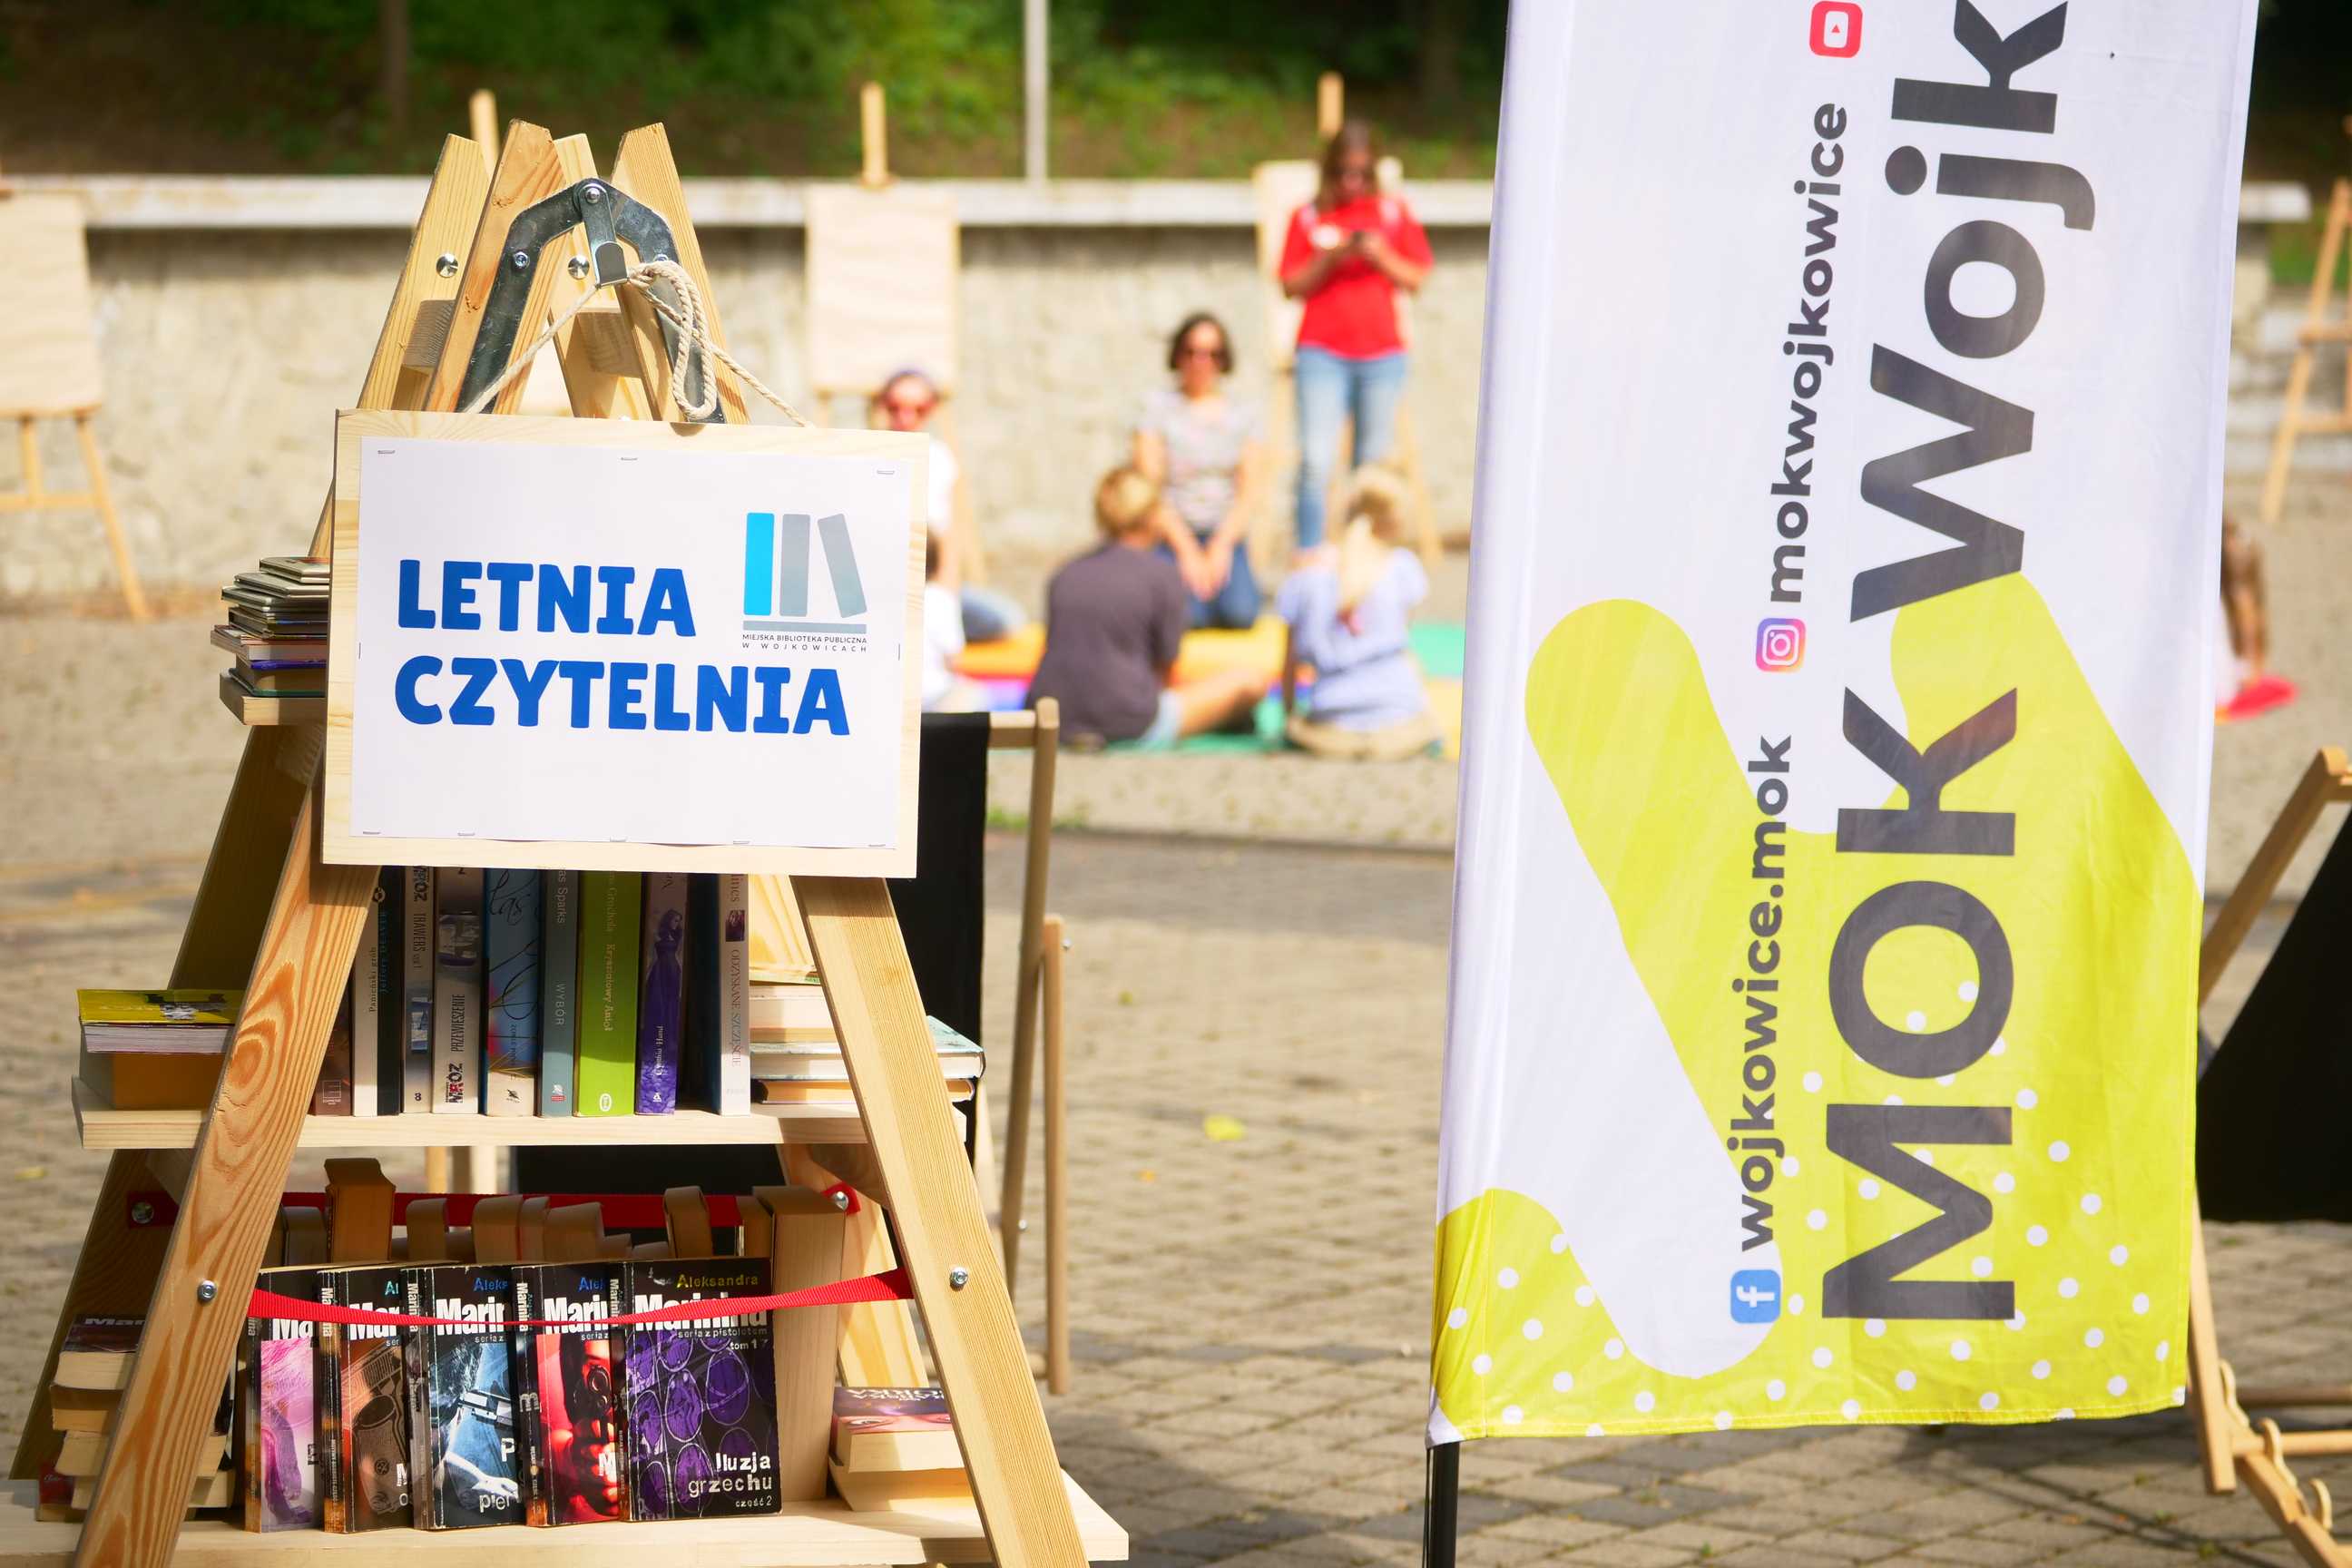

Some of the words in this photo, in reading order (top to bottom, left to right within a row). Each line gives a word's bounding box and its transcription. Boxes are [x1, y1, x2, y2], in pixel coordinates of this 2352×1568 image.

[1850, 0, 2095, 622] Wojk
[1770, 103, 1847, 603] mokwojkowice
[397, 558, 696, 637] LETNIA
[760, 642, 867, 652] WOJKOWICACH
[824, 636, 867, 644] PUBLICZNA
[395, 655, 850, 736] CZYTELNIA
[557, 887, 568, 924] Sparks
[555, 984, 566, 1026] WYBÓR
[1727, 735, 1791, 1252] wojkowice.mok
[1821, 687, 2017, 1319] MOK
[450, 995, 466, 1053] PRZEWIESZENIE
[676, 1273, 759, 1289] Aleksandra
[730, 1339, 750, 1350] tom
[715, 1451, 771, 1474] Iluzja
[688, 1474, 772, 1499] grzechu
[766, 1494, 773, 1506] 2
